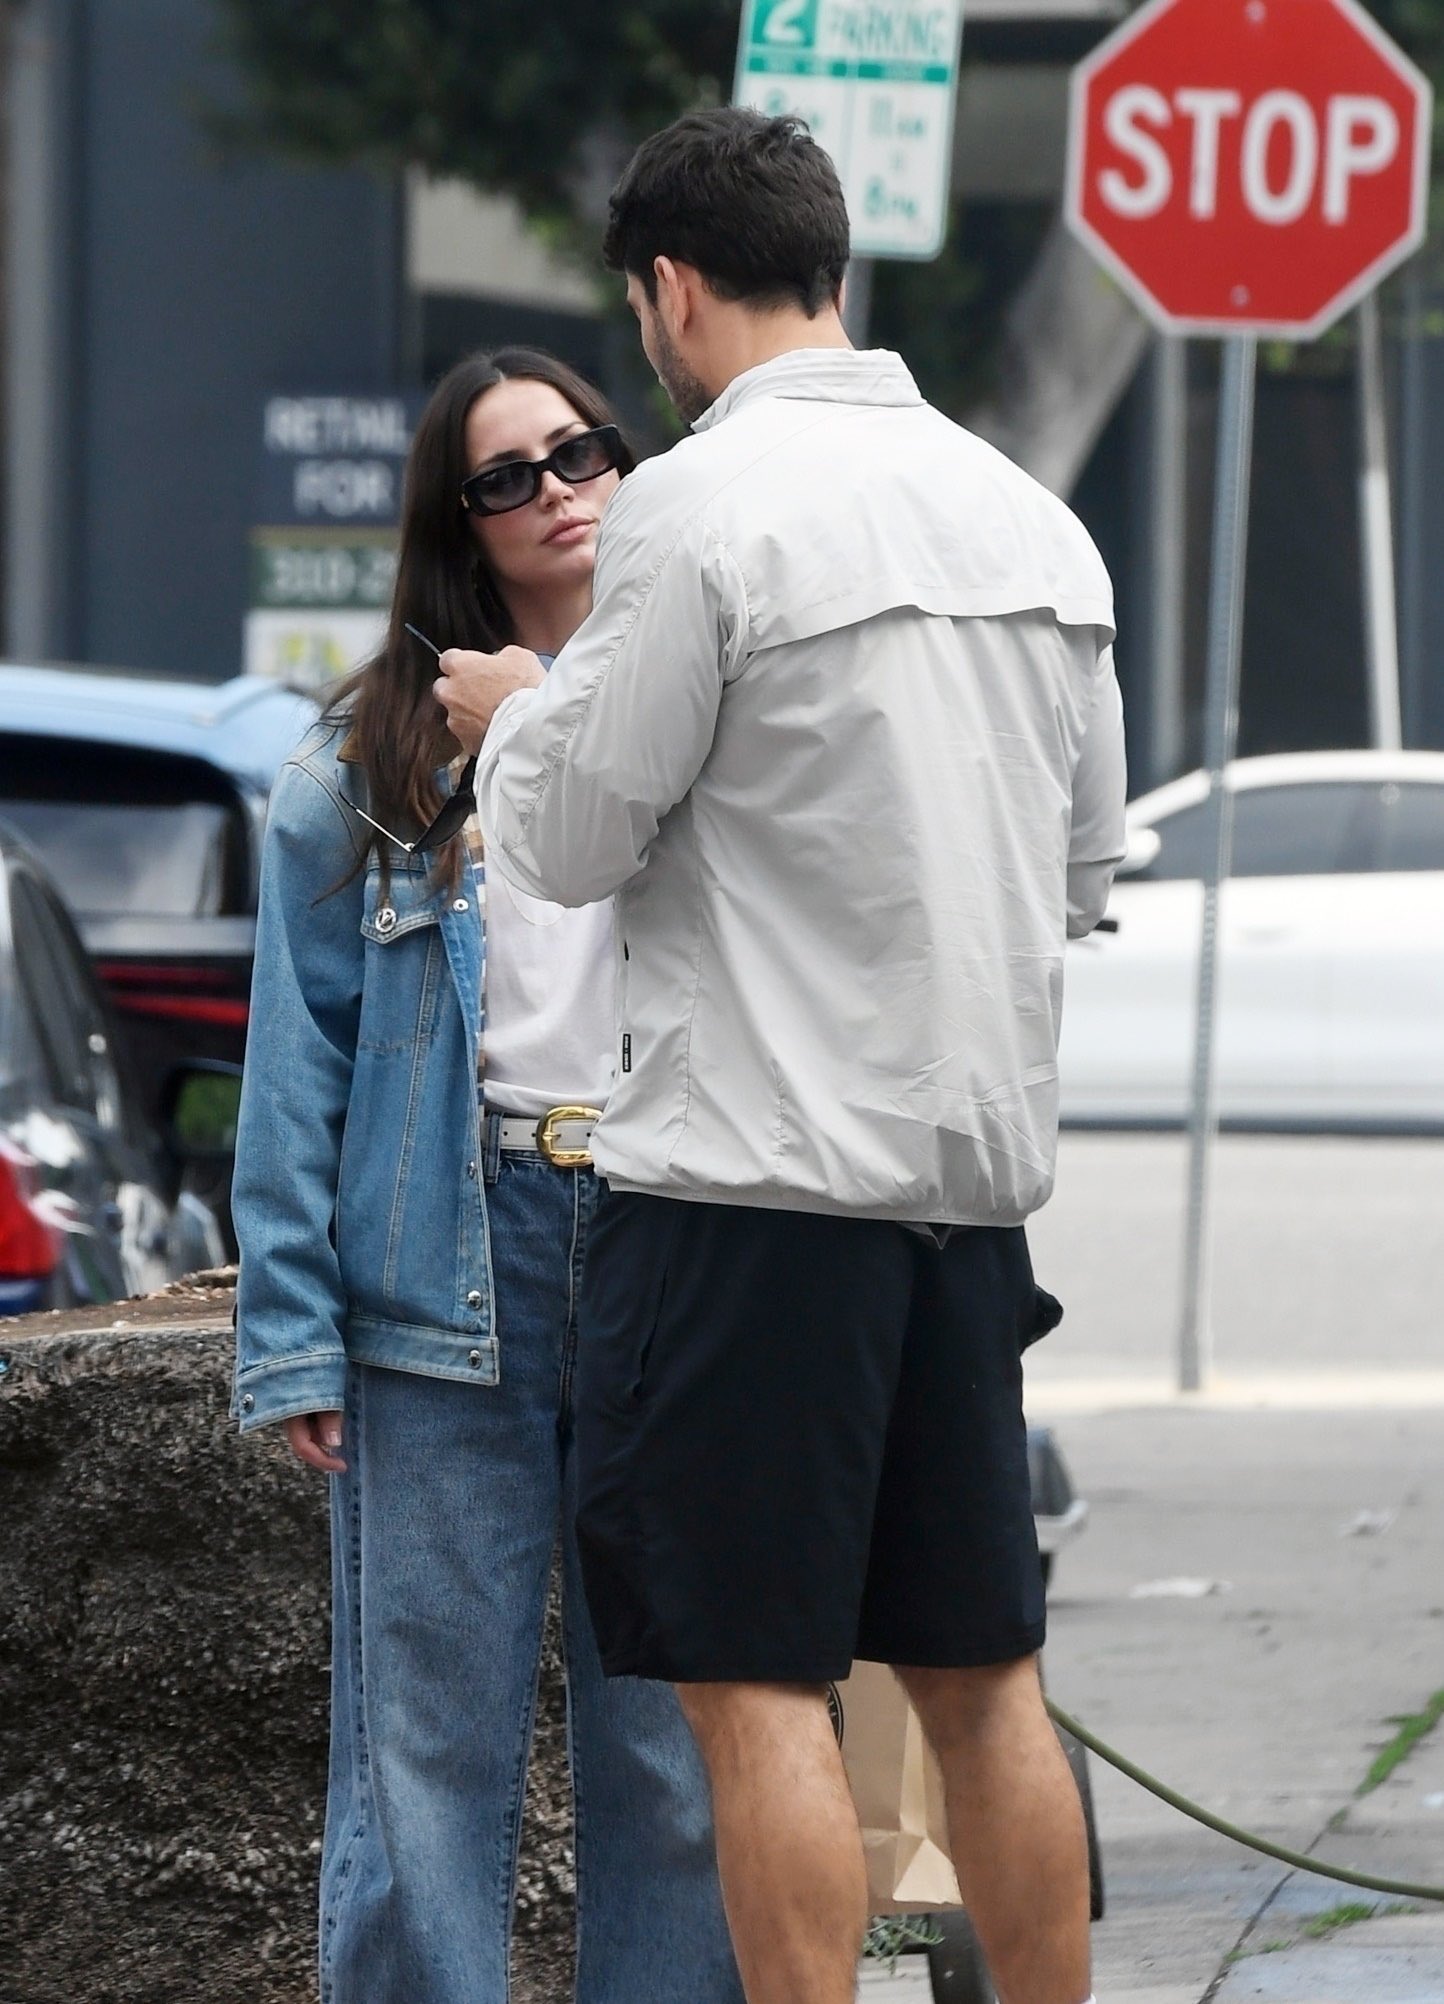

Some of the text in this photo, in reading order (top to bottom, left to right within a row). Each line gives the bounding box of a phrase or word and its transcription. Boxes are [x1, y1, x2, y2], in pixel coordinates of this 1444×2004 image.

[824, 3, 947, 57] PARKING
[1099, 84, 1399, 226] STOP
[265, 397, 408, 453] RETAIL
[294, 459, 393, 516] FOR
